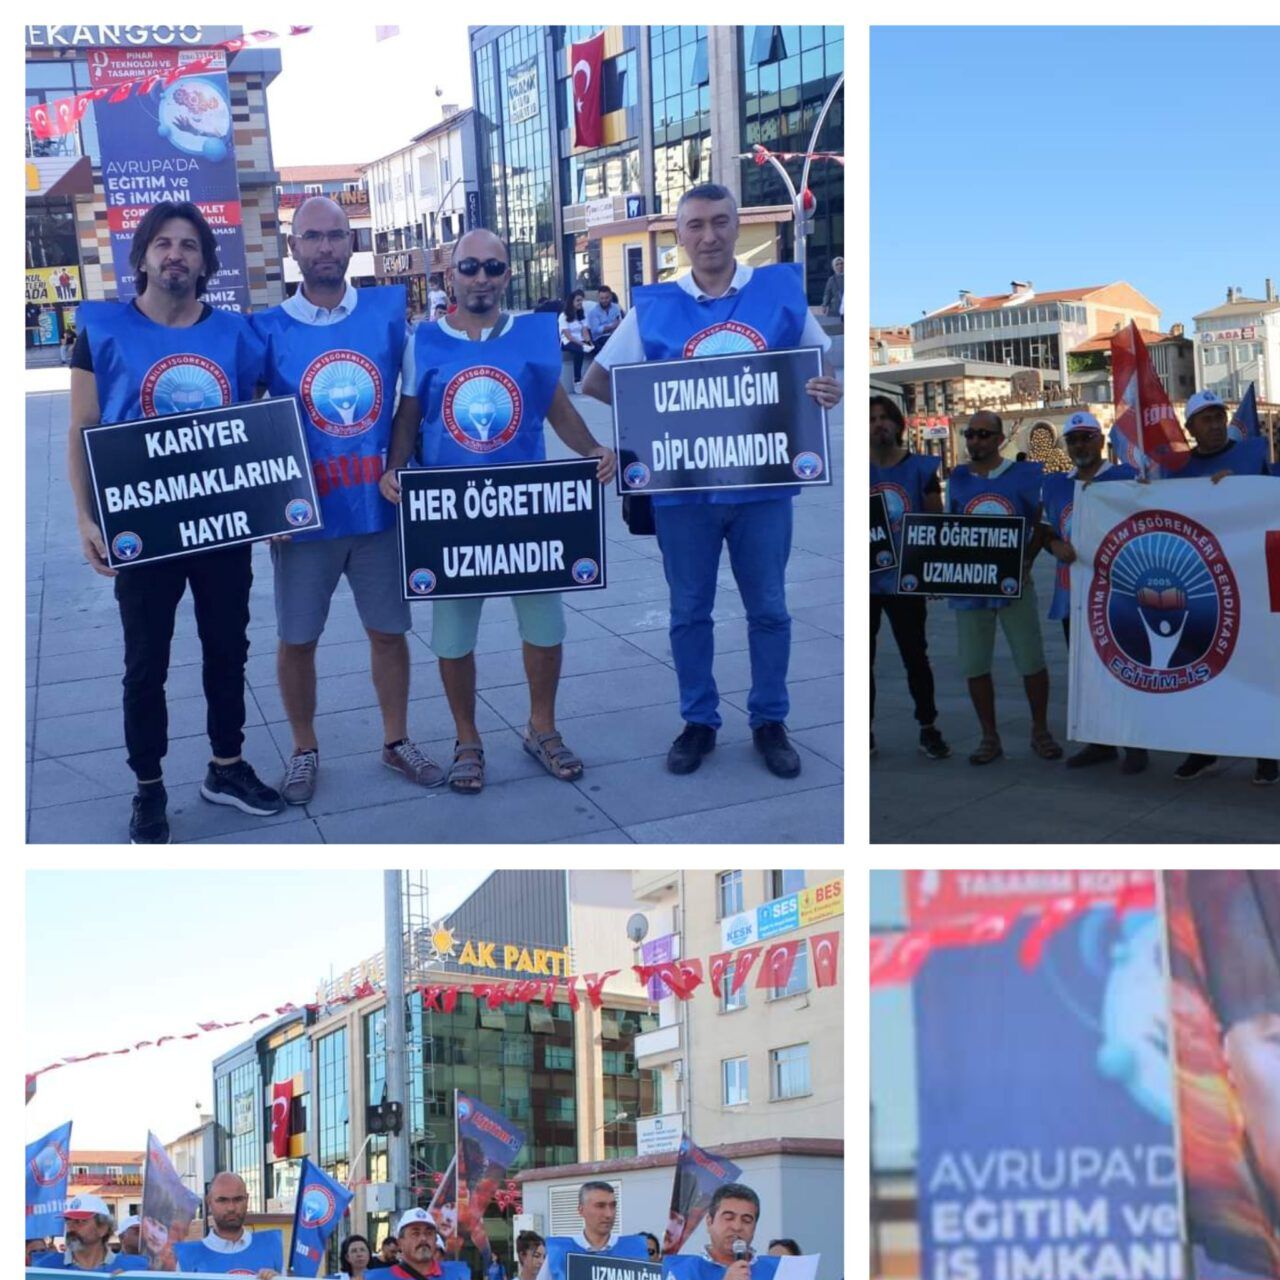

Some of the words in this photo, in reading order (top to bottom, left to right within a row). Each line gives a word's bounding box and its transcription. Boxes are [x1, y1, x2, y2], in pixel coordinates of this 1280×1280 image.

[25, 25, 202, 45] EKANGOO
[107, 69, 146, 78] TASARIM
[106, 158, 200, 175] AVRUPA'DA
[170, 177, 189, 188] ve
[653, 366, 780, 413] UZMANLIĞIM
[145, 419, 248, 458] KARİYER
[652, 431, 790, 472] DİPLOMAMDIR
[104, 455, 302, 513] BASAMAKLARINA
[408, 488, 457, 522] HER
[463, 478, 593, 520] ÖĞRETMEN
[178, 511, 251, 547] HAYIR
[907, 525, 936, 546] HER
[940, 522, 1018, 549] ÖĞRETMEN
[443, 540, 565, 578] UZMANDIR
[1101, 529, 1130, 565] BİLİM
[923, 562, 998, 584] UZMANDIR
[772, 898, 798, 918] SES
[815, 881, 841, 903] BES
[726, 925, 752, 942] KESK
[458, 940, 496, 969] AK
[504, 944, 571, 977] PARTİ
[929, 1144, 1178, 1193] AVRUPA'D
[1123, 1204, 1179, 1237] ve
